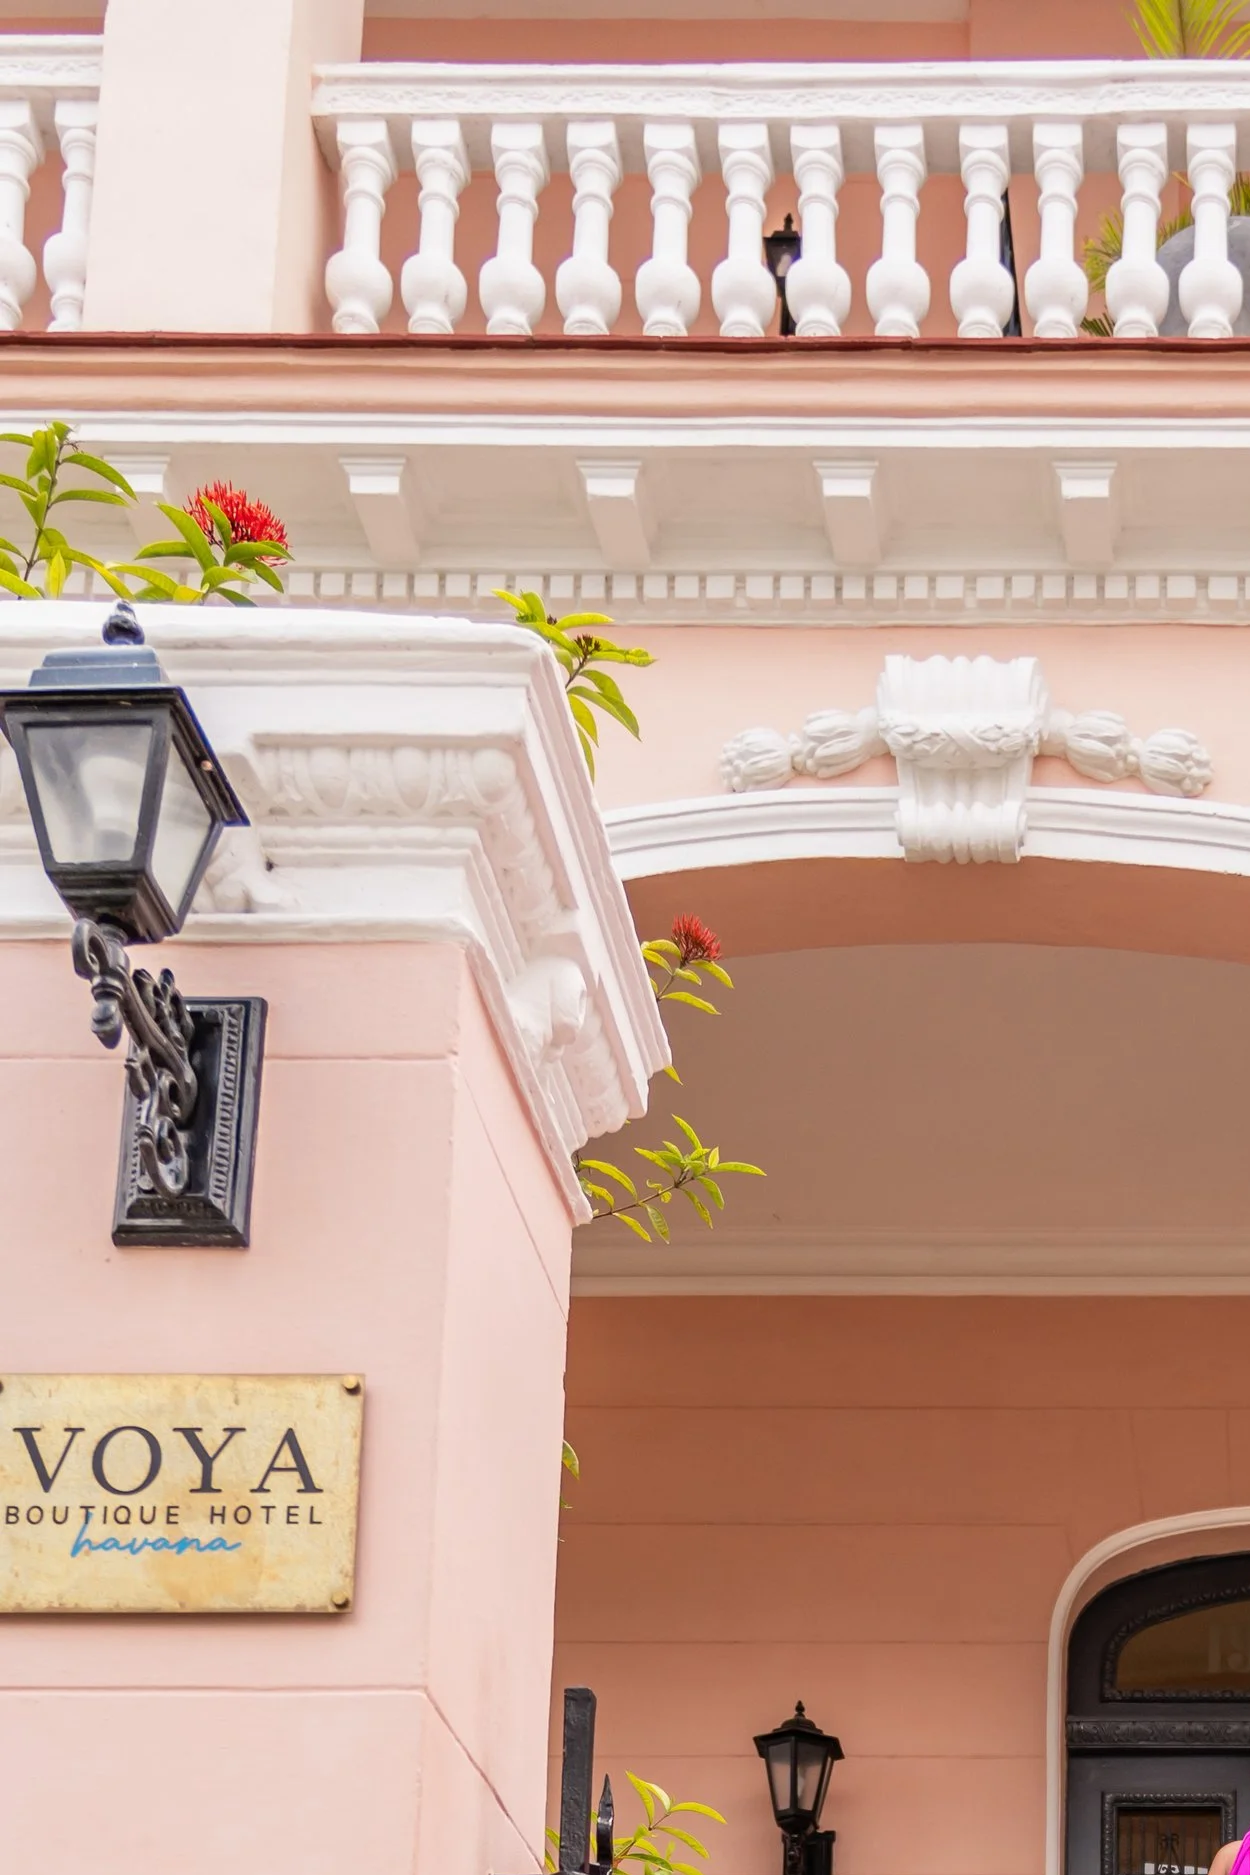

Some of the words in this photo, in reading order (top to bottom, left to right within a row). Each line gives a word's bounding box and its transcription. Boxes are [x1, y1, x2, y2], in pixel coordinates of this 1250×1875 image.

[12, 1425, 324, 1496] VOYA
[5, 1505, 181, 1525] BOUTIQUE
[209, 1505, 323, 1525] HOTEL
[70, 1511, 242, 1558] havana
